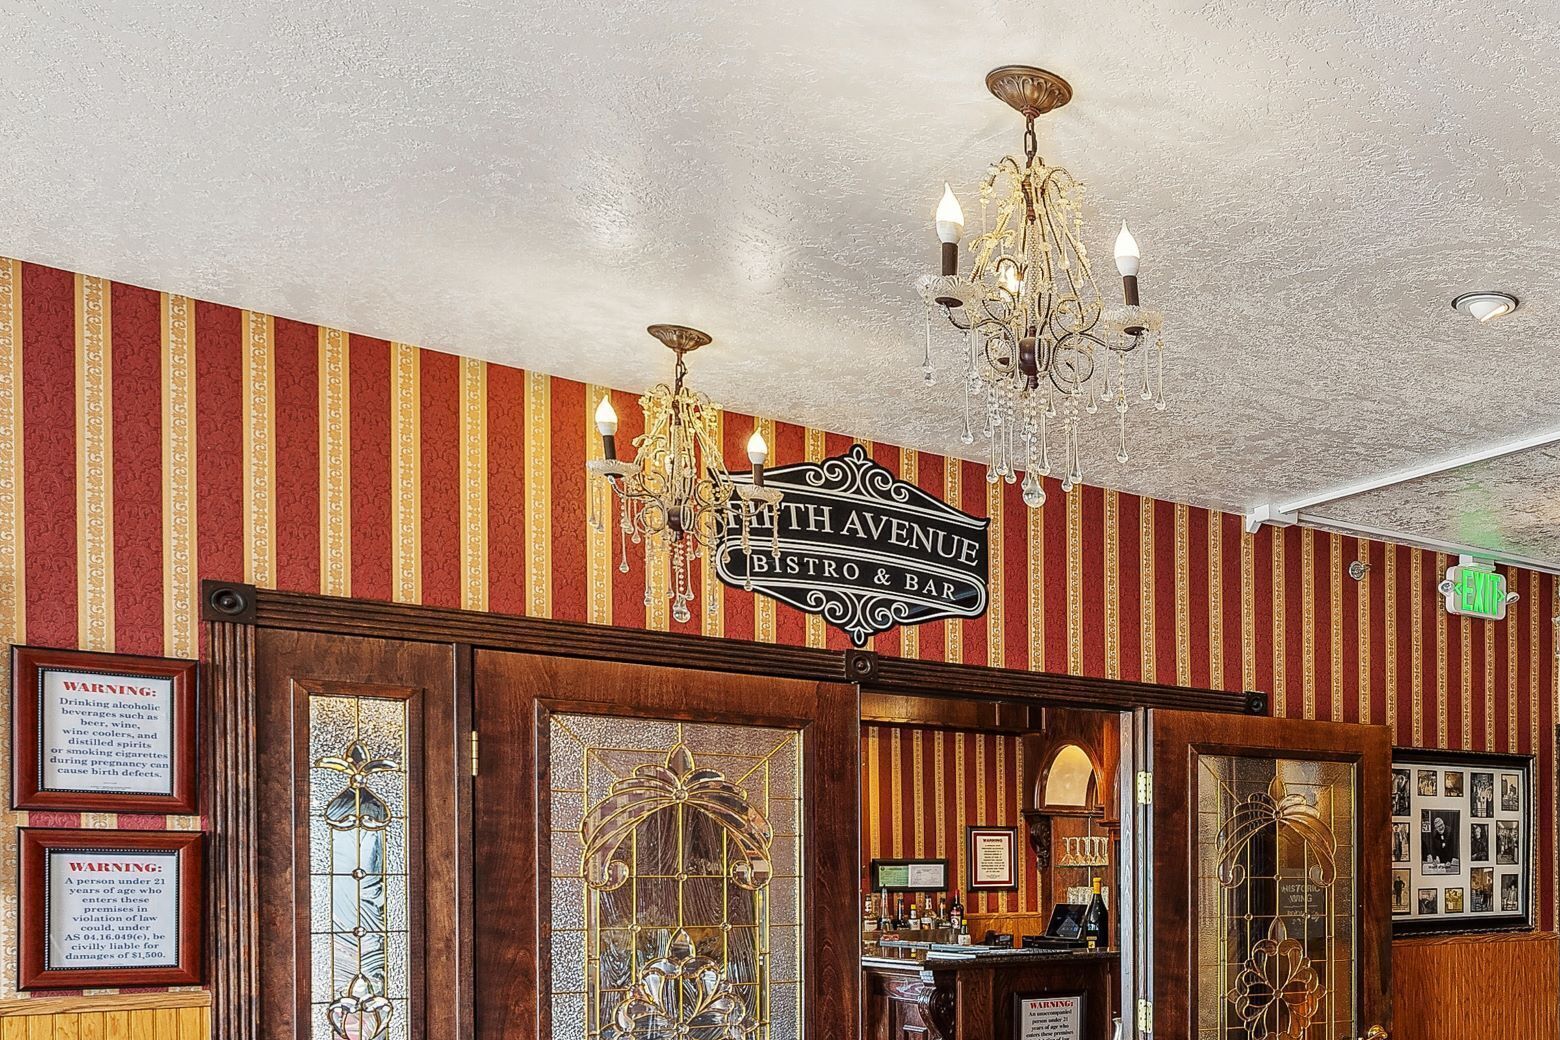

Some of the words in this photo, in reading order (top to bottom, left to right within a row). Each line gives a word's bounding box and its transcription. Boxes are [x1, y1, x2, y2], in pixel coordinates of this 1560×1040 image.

[840, 510, 980, 566] AVENUE
[752, 554, 859, 580] BISTRO
[874, 568, 891, 586] &
[904, 574, 956, 600] BAR
[1462, 569, 1501, 615] EXIT
[64, 681, 157, 697] WARNING:
[60, 697, 110, 708] Drinking
[113, 701, 160, 711] alcoholic
[62, 708, 116, 718] beverages
[93, 730, 134, 739] coolers,
[68, 738, 113, 746] distilled
[117, 741, 152, 749] spirits
[66, 749, 112, 757] smoking
[115, 751, 168, 759] cigarettes
[50, 756, 87, 766] during
[91, 760, 148, 768] pregnancy
[92, 768, 119, 776] birth
[122, 769, 162, 778] defects.
[69, 863, 162, 872] WARNING:
[71, 943, 106, 951] civilly
[1030, 1001, 1073, 1009] WARNING:
